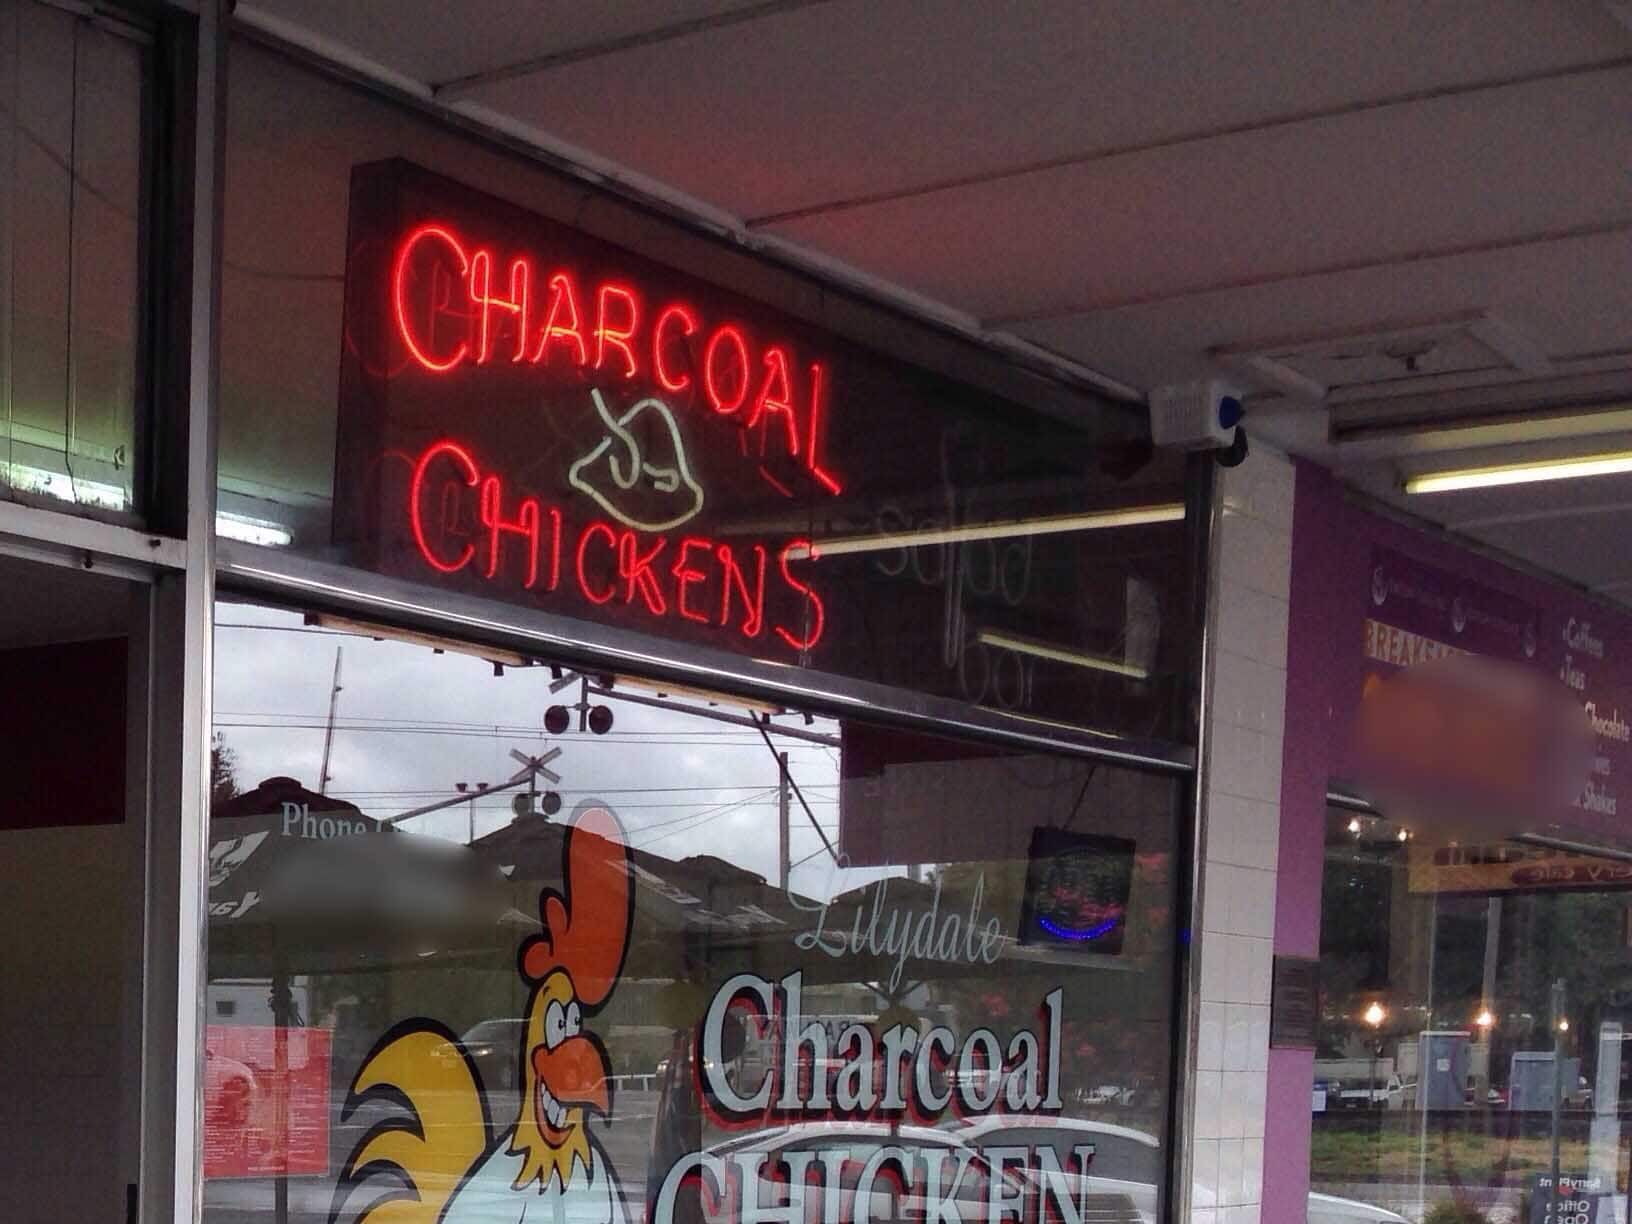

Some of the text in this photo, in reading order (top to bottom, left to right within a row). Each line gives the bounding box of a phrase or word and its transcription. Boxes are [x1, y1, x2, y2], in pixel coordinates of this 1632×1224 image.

[391, 223, 844, 498] CHARCOAL
[409, 439, 826, 653] CHICKENS
[789, 873, 1009, 993] Lilydale
[696, 970, 1065, 1130] Charcoal
